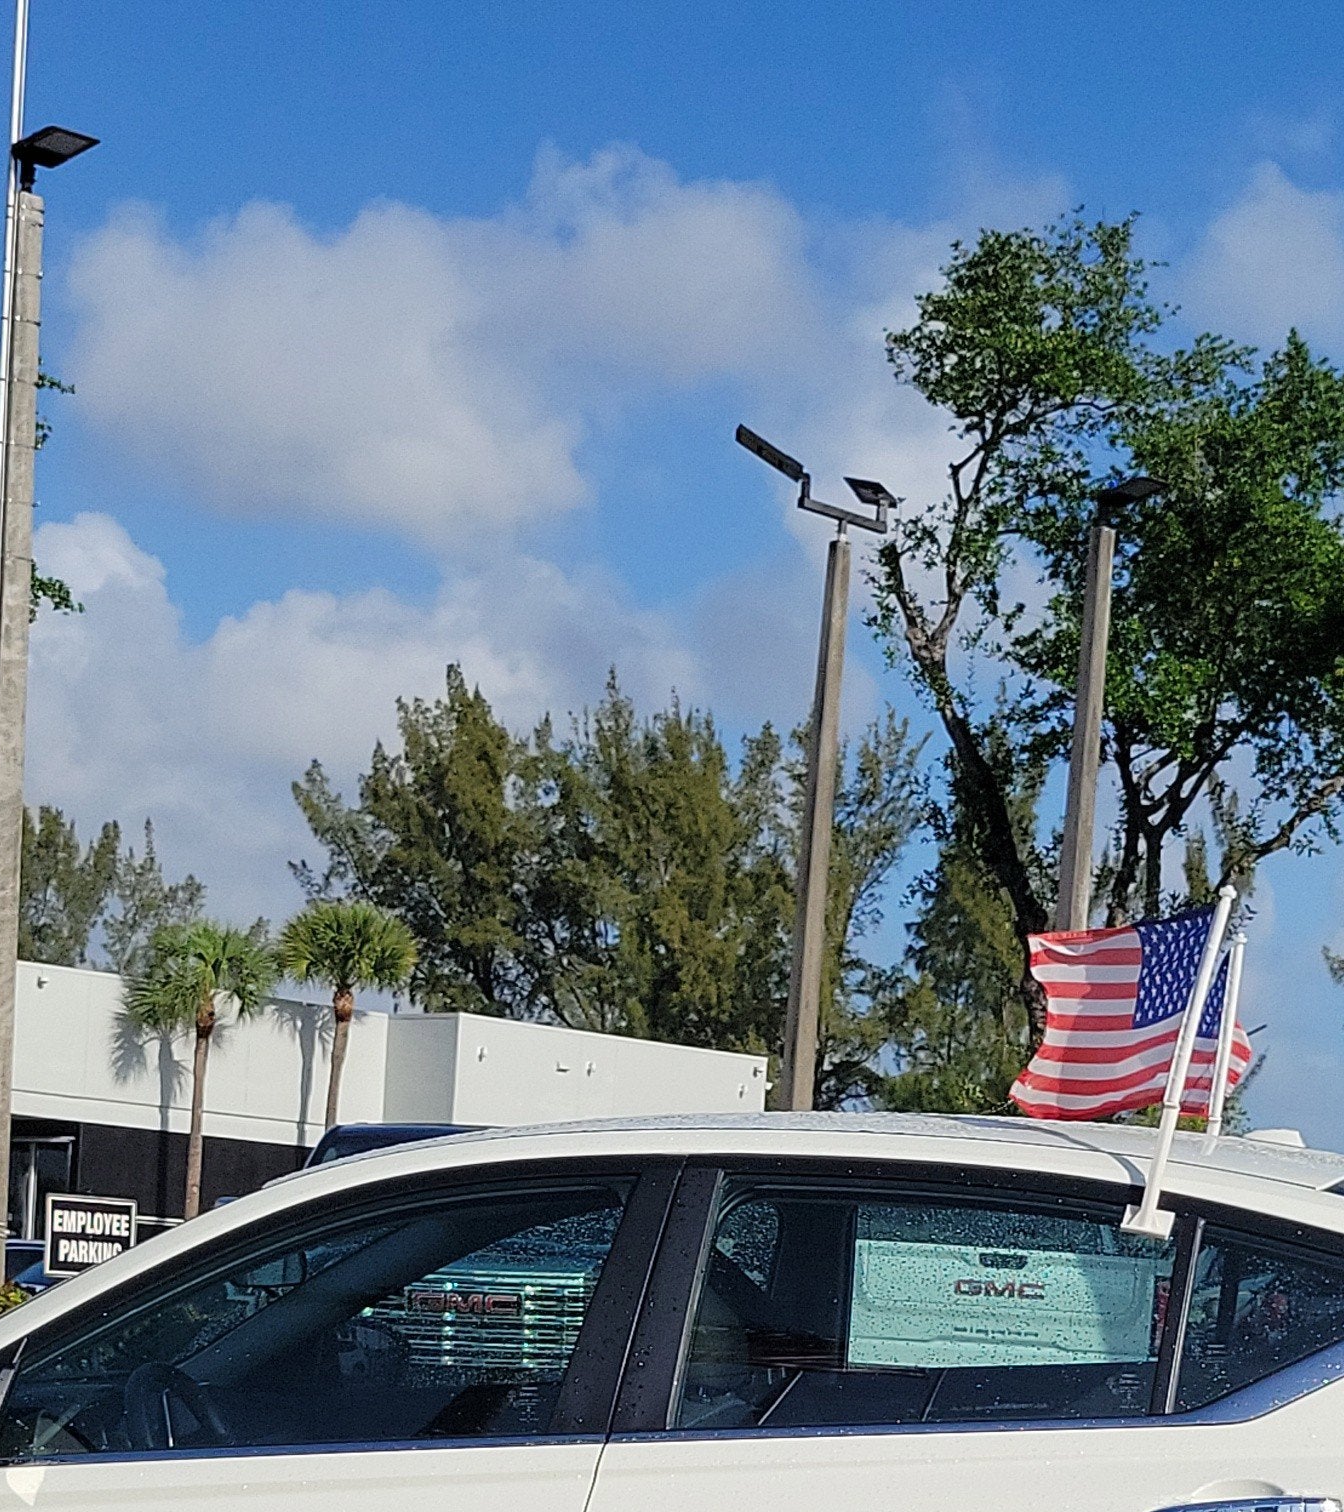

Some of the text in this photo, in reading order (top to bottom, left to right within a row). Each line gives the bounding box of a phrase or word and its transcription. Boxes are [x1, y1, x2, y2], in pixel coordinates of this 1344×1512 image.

[53, 1209, 130, 1237] EMPLOYEE
[956, 1278, 1045, 1300] GMC
[410, 1292, 519, 1313] GMC
